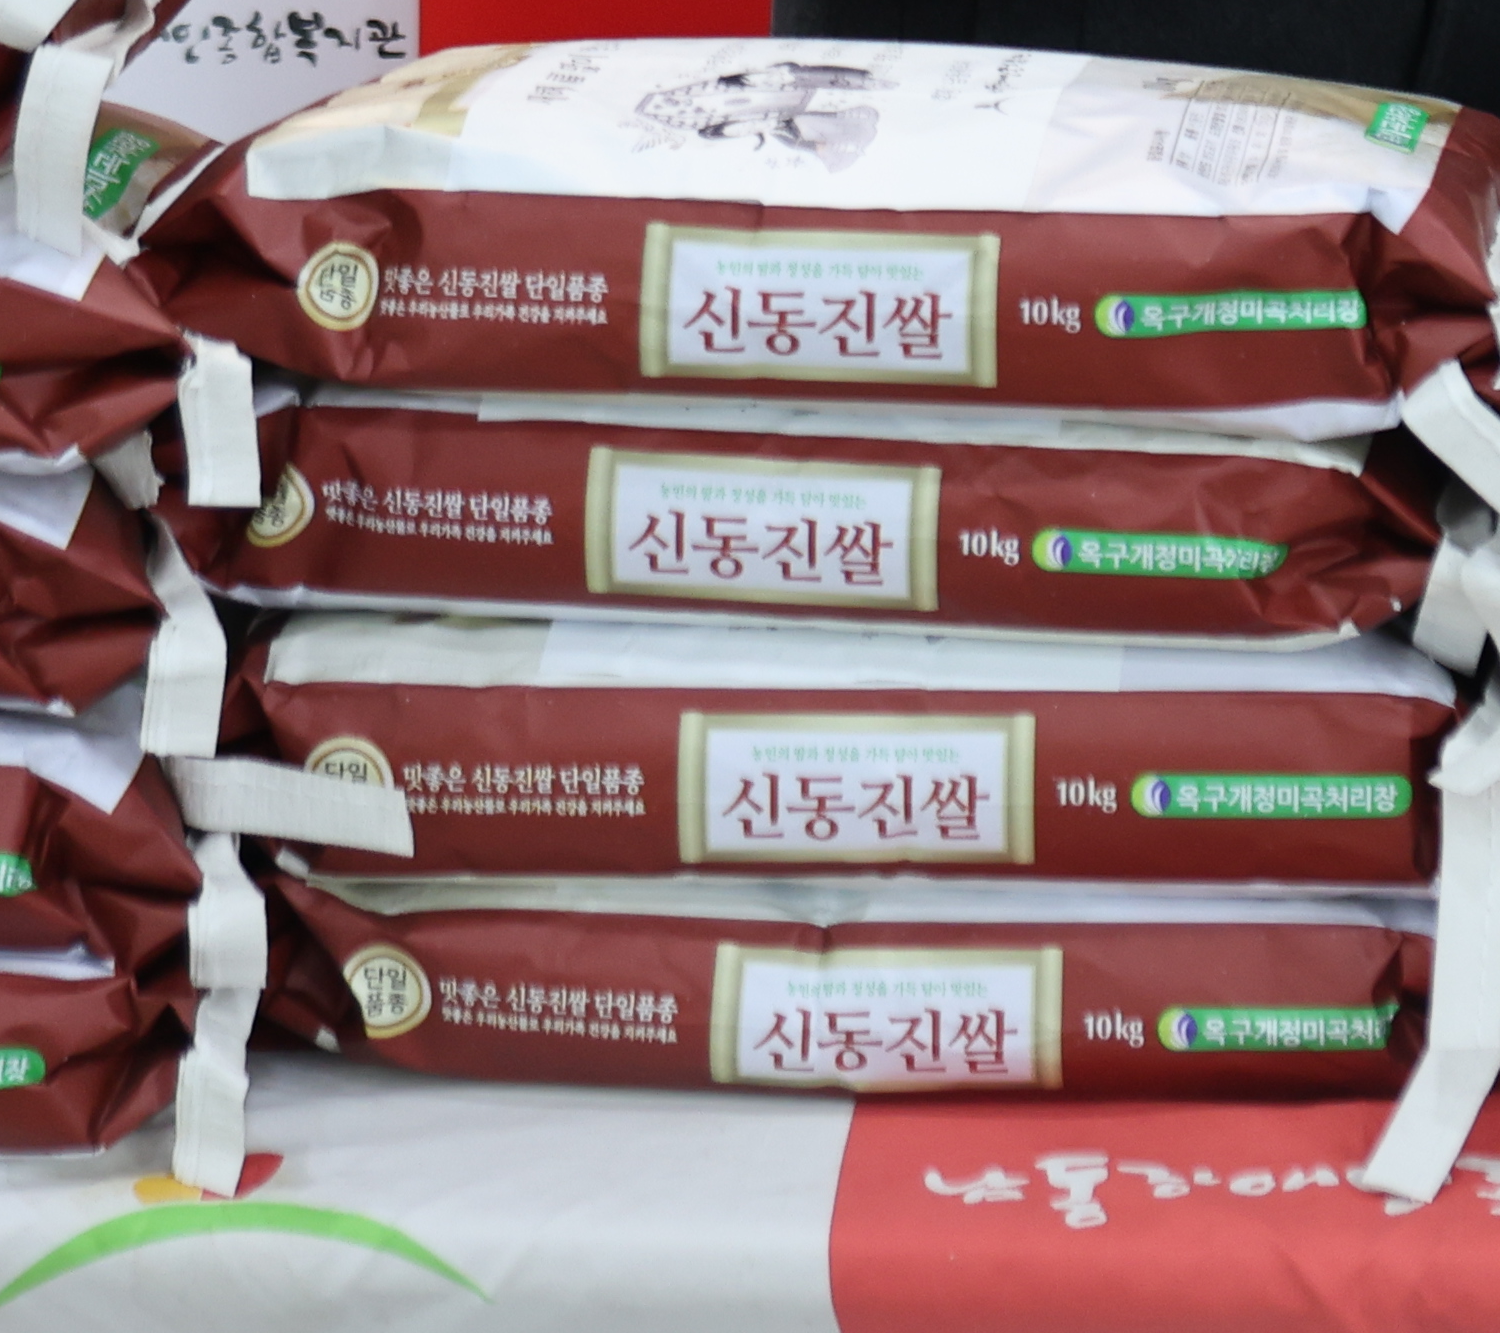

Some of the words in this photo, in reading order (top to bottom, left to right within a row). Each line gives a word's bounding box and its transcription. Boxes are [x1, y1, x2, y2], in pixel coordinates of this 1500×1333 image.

[159, 11, 407, 68] 인종합복지관
[439, 269, 521, 302] 신동진쌀
[525, 272, 608, 303] 단일품종
[685, 288, 951, 359] 신동진쌀
[1020, 297, 1080, 332] 10kg
[1141, 298, 1359, 330] 옥구개정미곡처리장
[384, 488, 465, 519] 신동진쌀
[469, 493, 552, 525] 단일품종
[630, 511, 893, 585] 신동진쌀
[960, 529, 1019, 565] 10kg
[403, 764, 466, 792] 맛좋은
[472, 764, 555, 793] 신동진쌀
[560, 765, 644, 799] 단일품종
[1057, 778, 1117, 812] 10kg
[1176, 782, 1397, 812] 옥구개정미곡처리장
[725, 774, 988, 840] 신동진쌀
[440, 979, 500, 1012] 맛좋은
[507, 984, 590, 1017] 신동진쌀
[594, 991, 678, 1024] 단일품종
[756, 1009, 1016, 1075] 신동진쌀
[1084, 1011, 1144, 1046] 10kg
